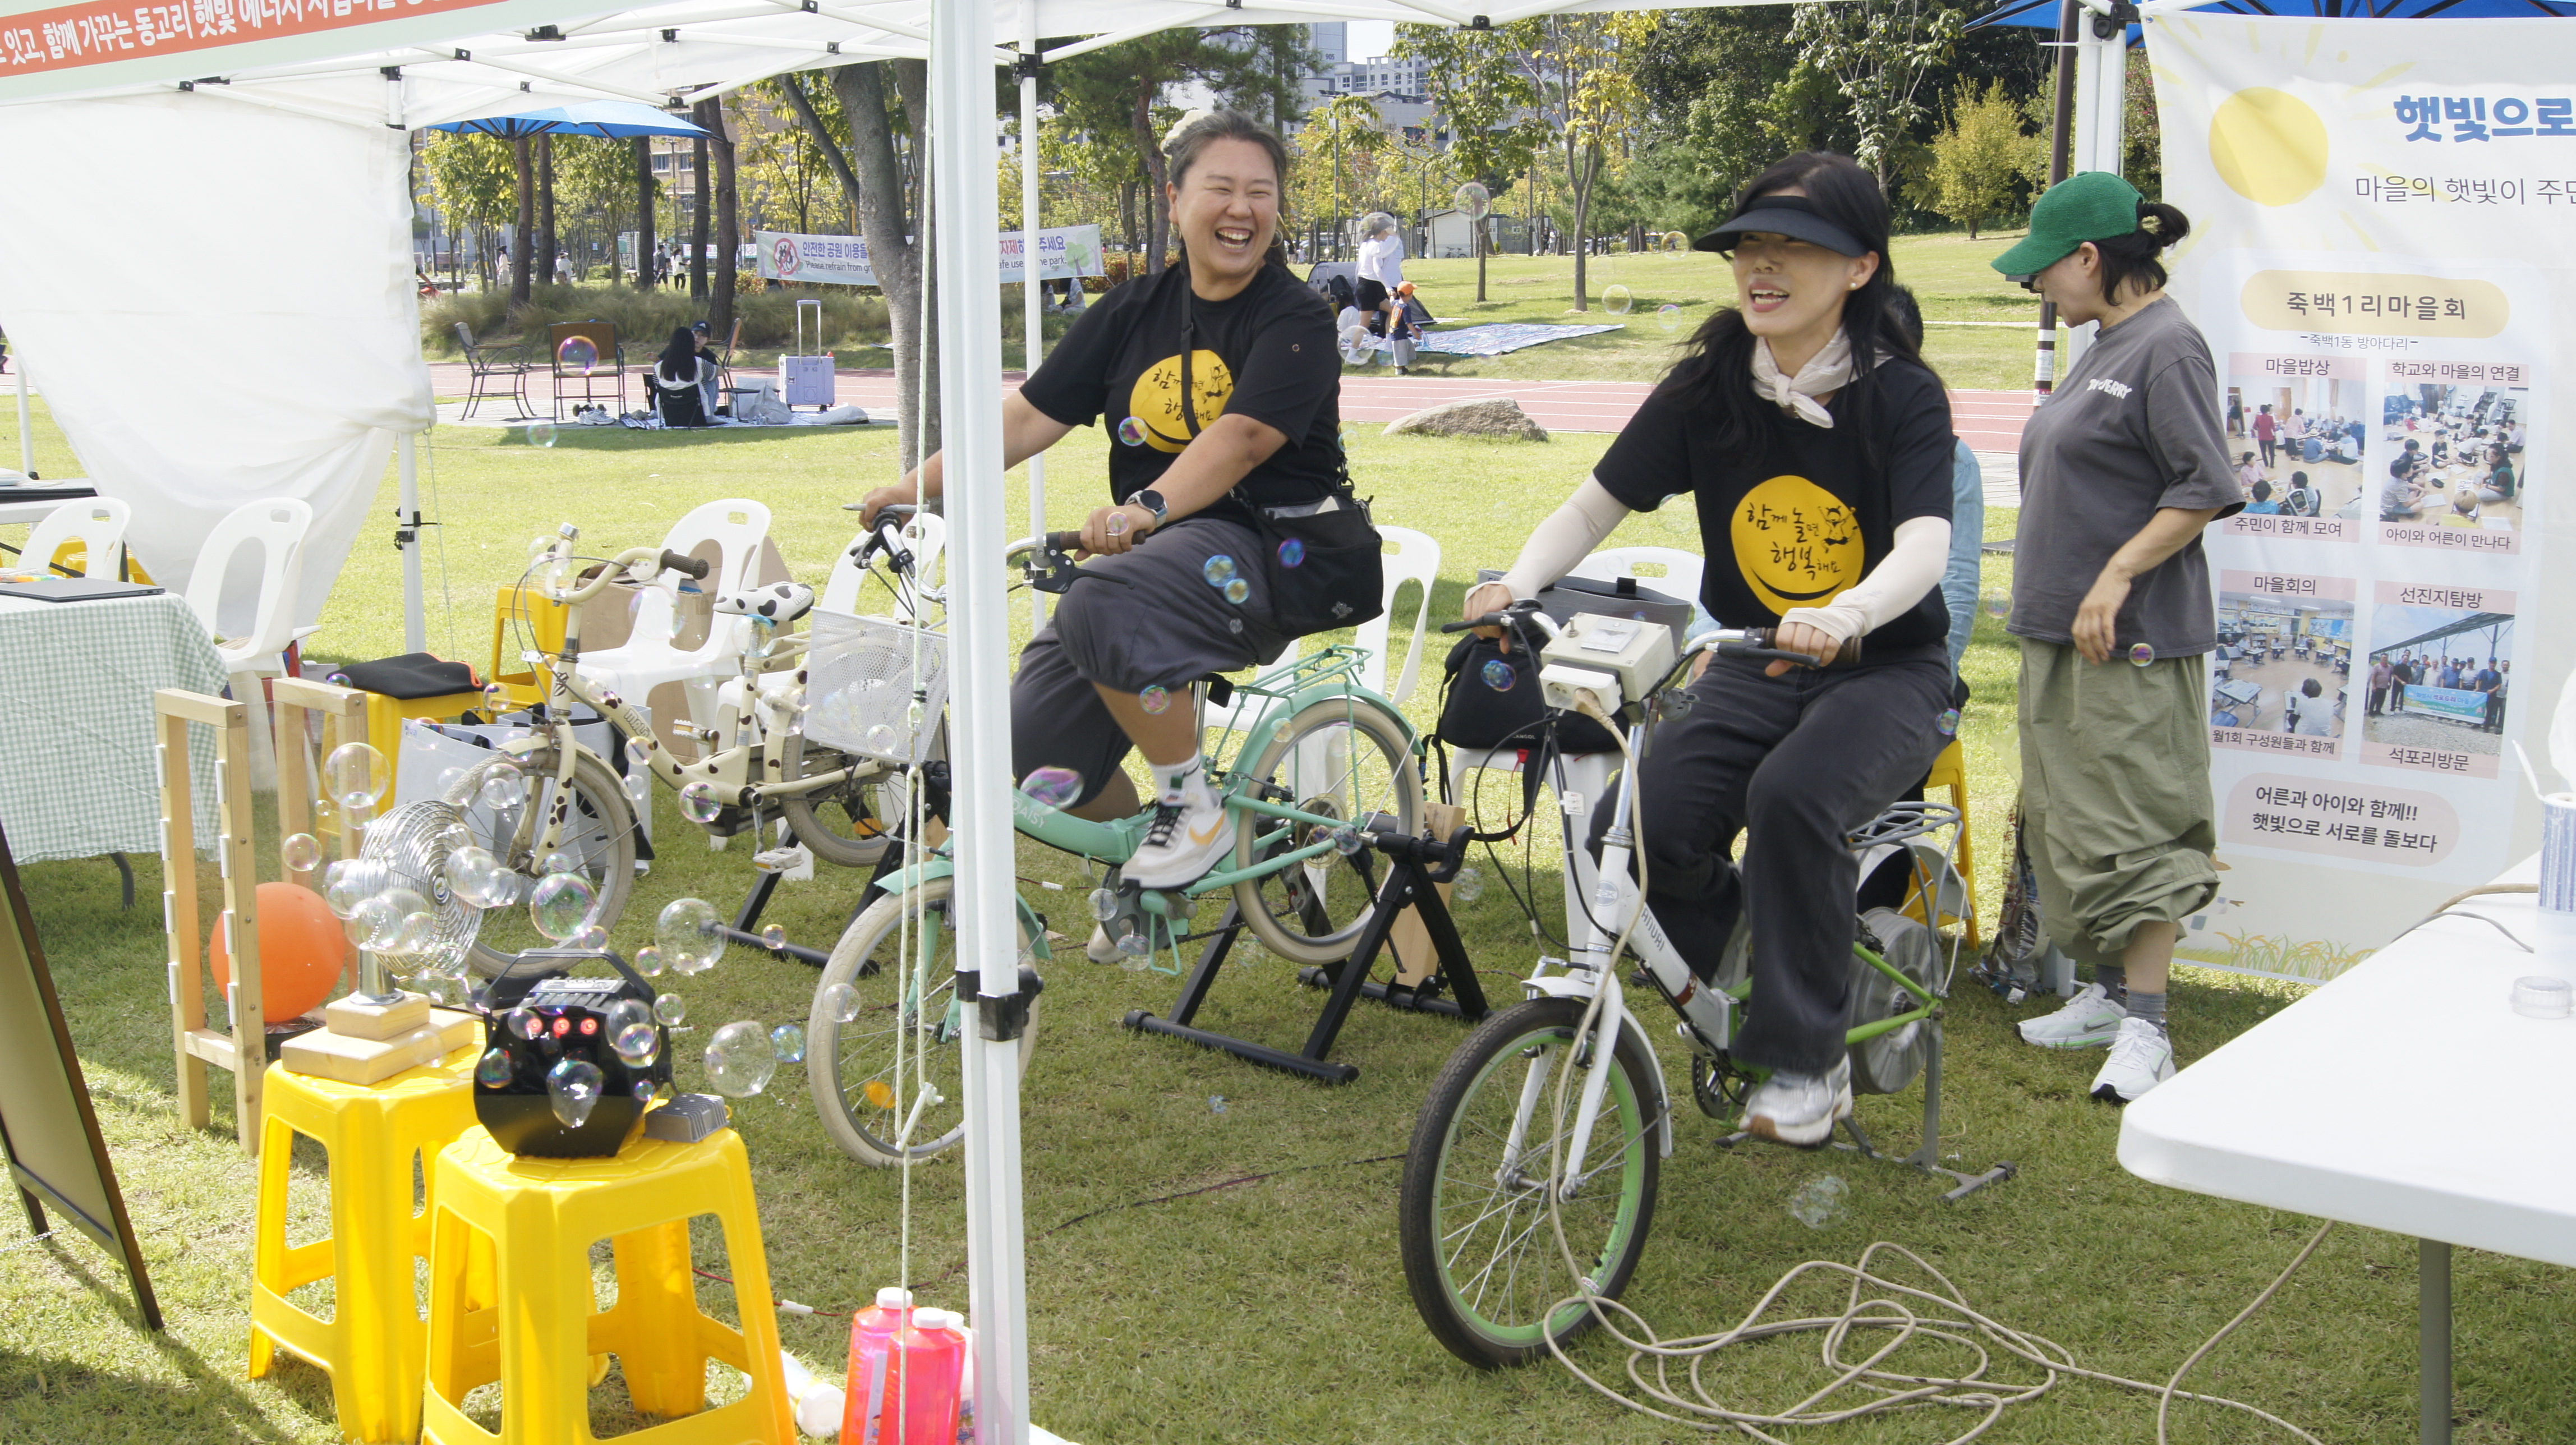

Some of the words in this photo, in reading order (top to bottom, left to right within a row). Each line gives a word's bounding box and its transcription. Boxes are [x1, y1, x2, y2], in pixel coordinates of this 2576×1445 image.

[4, 27, 46, 66] 잇고,
[43, 19, 82, 59] 함께
[79, 12, 135, 53] 가꾸는
[135, 0, 194, 46] 동고리
[194, 0, 237, 38] 햇빛
[2393, 94, 2576, 144] 햇빛으로
[2356, 175, 2436, 203] 마을의
[2445, 177, 2527, 205] 햇빛이
[802, 241, 826, 257] 안전한
[827, 242, 843, 258] 공원
[1039, 235, 1066, 252] 주세요
[805, 260, 825, 270] Please
[825, 262, 846, 271] refrain
[847, 262, 863, 272] from
[999, 259, 1010, 269] afe
[1011, 260, 1024, 268] use
[2265, 357, 2330, 377] 마을밥상
[2391, 362, 2437, 378] 학교와
[2440, 363, 2485, 380] 마을의
[2490, 366, 2520, 382] 연결
[1746, 501, 1787, 531] 함께
[1792, 507, 1820, 544] 놀면
[2234, 517, 2276, 533] 주민이
[2280, 519, 2309, 536] 함께
[2312, 522, 2342, 537] 모여
[2386, 527, 2426, 544] 아이와
[2428, 531, 2467, 548] 어른이
[2471, 533, 2510, 551] 만나다
[2253, 576, 2316, 596] 마을회의
[2399, 587, 2483, 609] 선진지탐방
[2212, 729, 2242, 746] 월1회
[2246, 733, 2307, 753] 구성원들과
[2310, 738, 2335, 756] 함께
[2389, 748, 2470, 772] 석포리방문
[2255, 786, 2308, 809] 어른과
[2312, 793, 2365, 816] 아이와
[2370, 799, 2418, 822] 함께!!
[2252, 813, 2321, 837] 햇빛으로
[2325, 822, 2379, 846] 서로를
[2382, 829, 2438, 854] 돌보다
